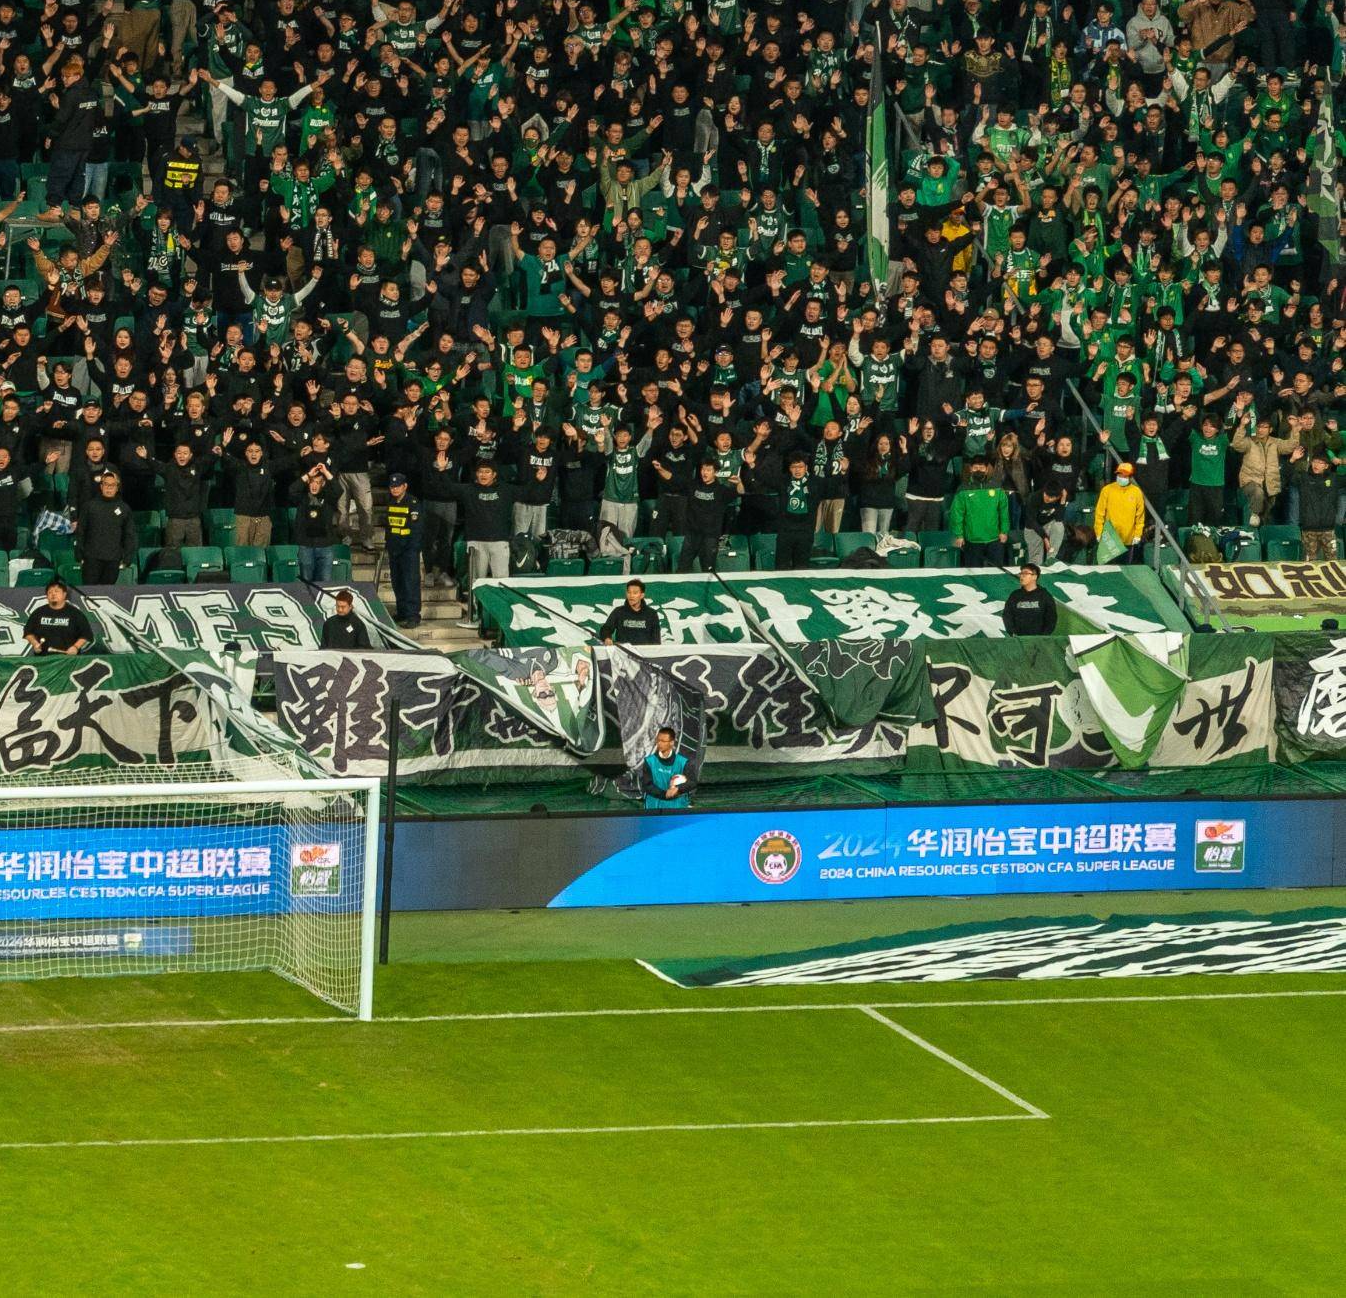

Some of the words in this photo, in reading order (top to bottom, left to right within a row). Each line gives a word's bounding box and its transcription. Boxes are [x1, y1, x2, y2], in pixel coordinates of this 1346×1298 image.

[820, 868, 853, 879] 2024
[856, 866, 897, 878] CHINA
[899, 864, 977, 877] RESOURCES
[981, 862, 1045, 875] C'ESTBON
[1047, 861, 1073, 873] CFA
[1076, 860, 1120, 872] SUPER
[1122, 859, 1175, 870] LEAGUE
